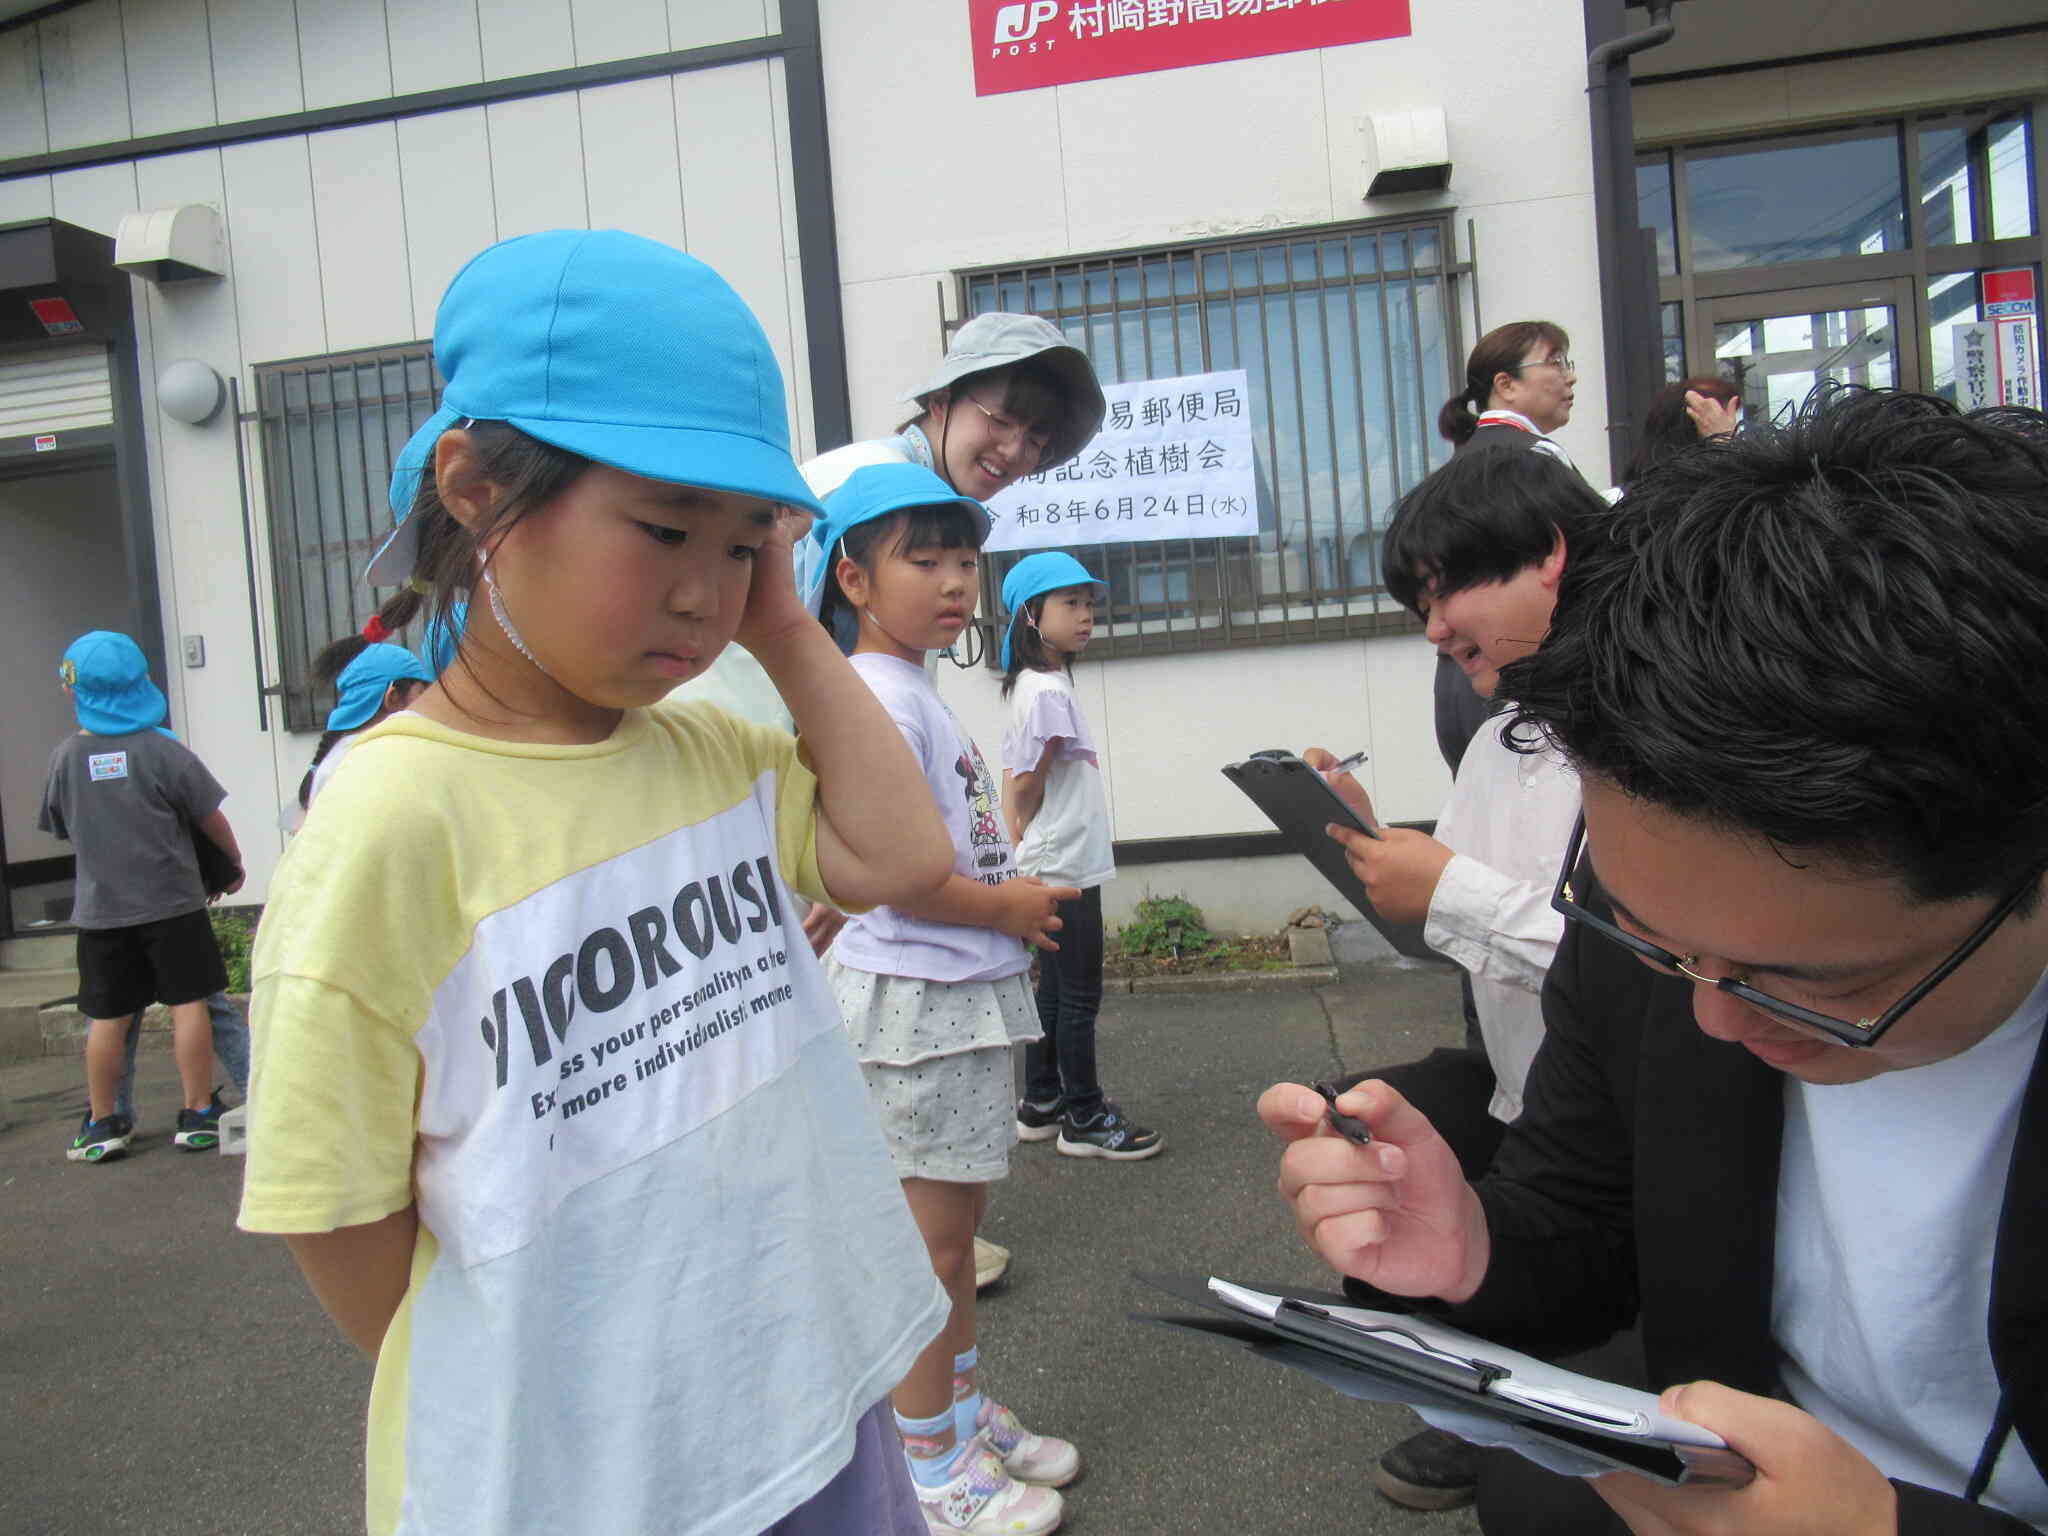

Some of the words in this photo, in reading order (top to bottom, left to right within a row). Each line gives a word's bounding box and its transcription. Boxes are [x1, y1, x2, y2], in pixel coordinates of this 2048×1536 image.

[992, 40, 1056, 59] POST
[591, 1022, 646, 1066] your
[562, 1072, 627, 1119] more
